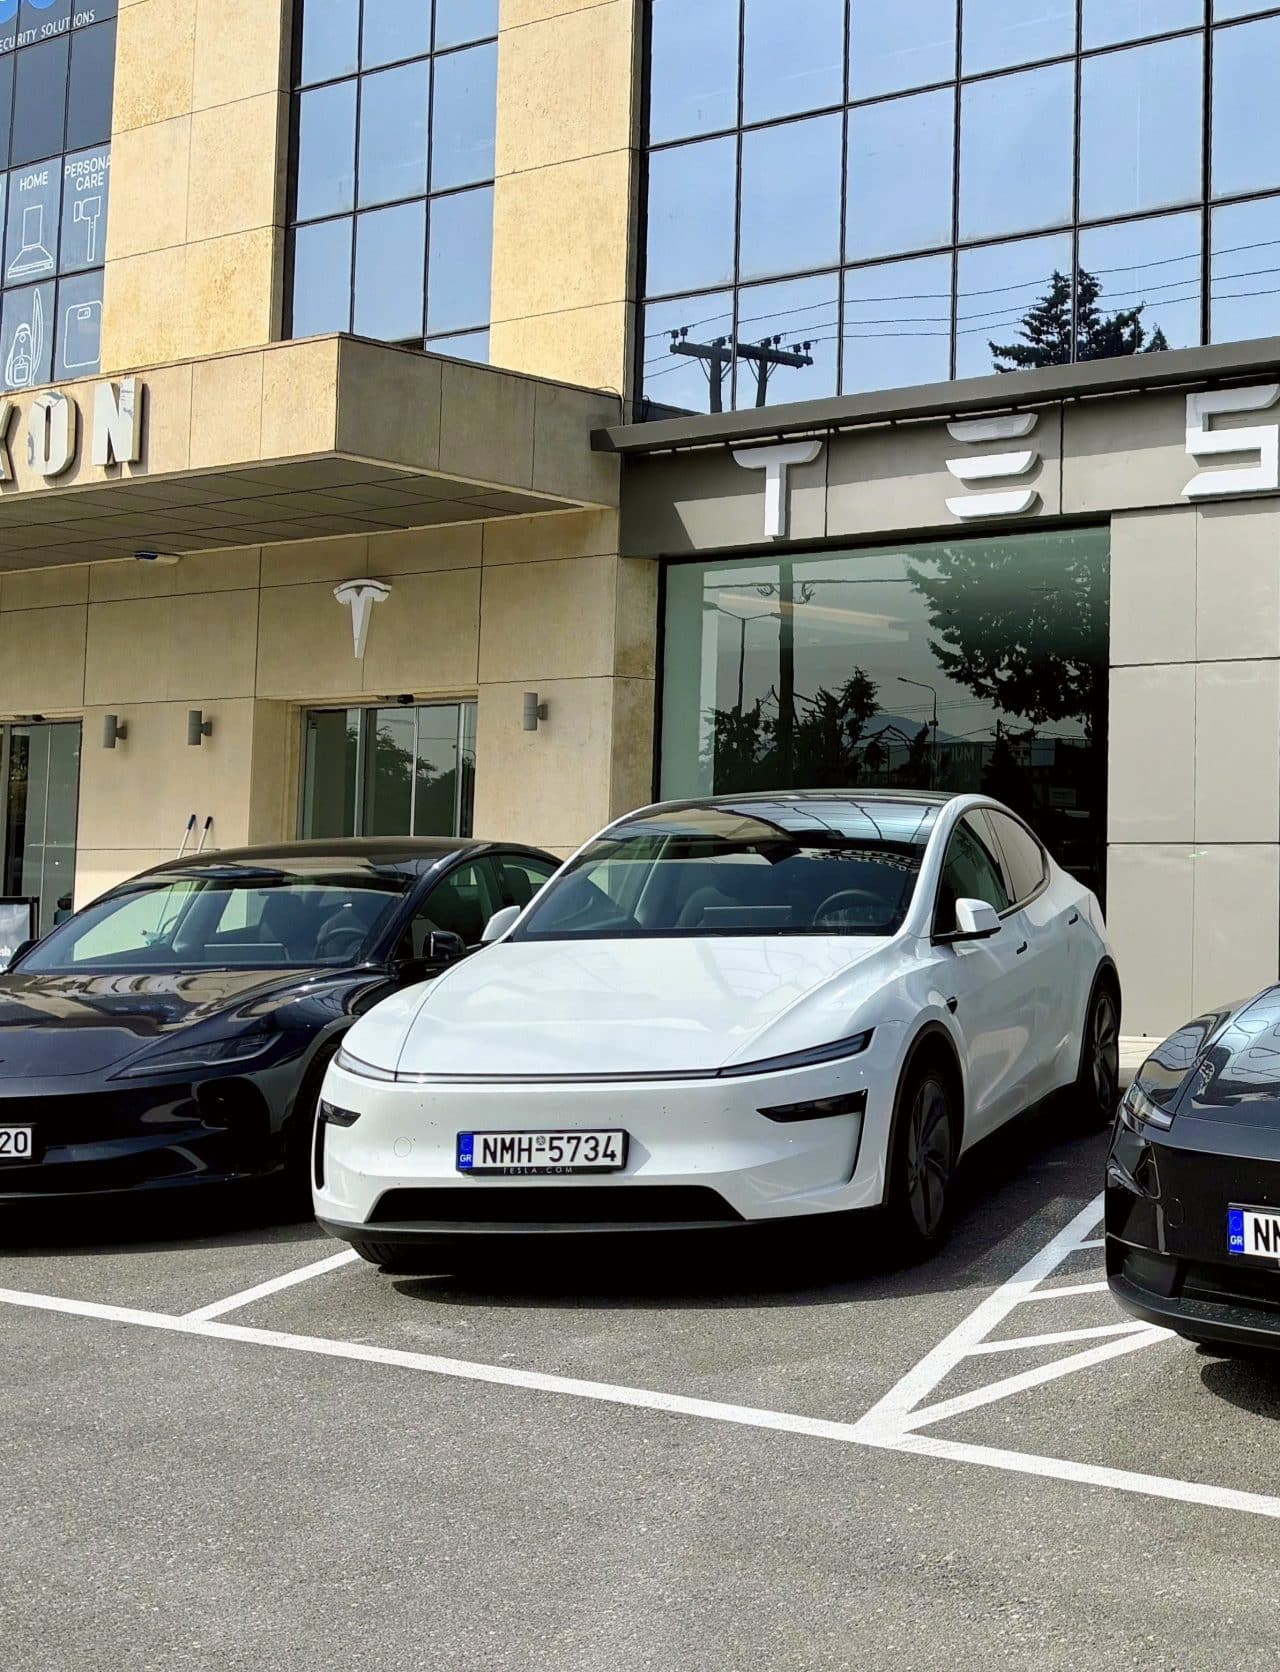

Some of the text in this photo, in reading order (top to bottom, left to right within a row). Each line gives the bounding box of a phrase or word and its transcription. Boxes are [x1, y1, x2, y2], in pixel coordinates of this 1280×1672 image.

[41, 9, 96, 38] SOLUTIONS
[20, 171, 49, 191] HOME
[76, 172, 105, 191] CARE
[460, 1154, 472, 1163] GR
[482, 1136, 617, 1164] NMH-5734
[503, 1166, 573, 1174] TESLA.COM
[1230, 1235, 1243, 1246] GR
